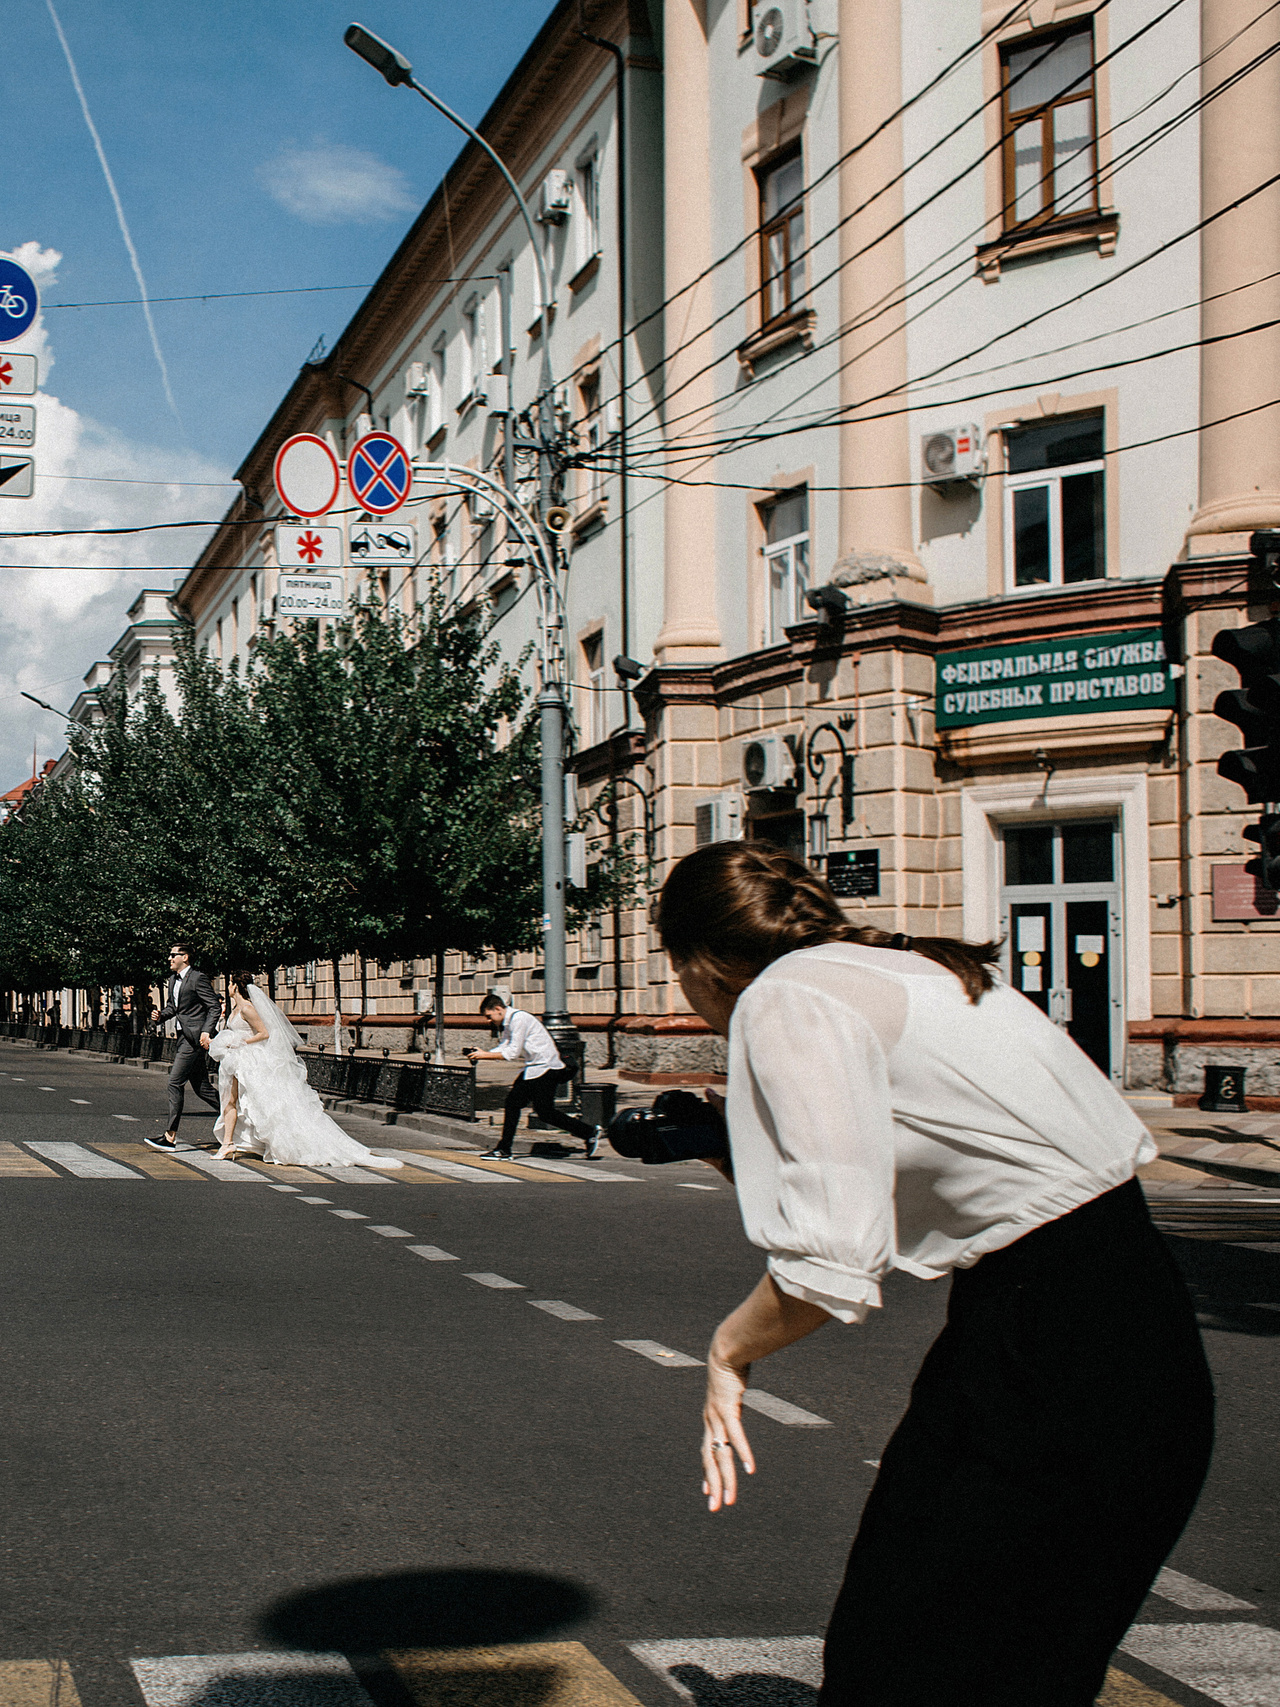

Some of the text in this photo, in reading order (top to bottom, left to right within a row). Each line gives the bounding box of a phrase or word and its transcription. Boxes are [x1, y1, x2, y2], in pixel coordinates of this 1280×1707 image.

[941, 641, 1166, 684] ФЕДЕРАЛЬНАЯ СЛУЖБА
[944, 672, 1166, 714] СУДЕБНЫХ ПРИСТАВОВ
